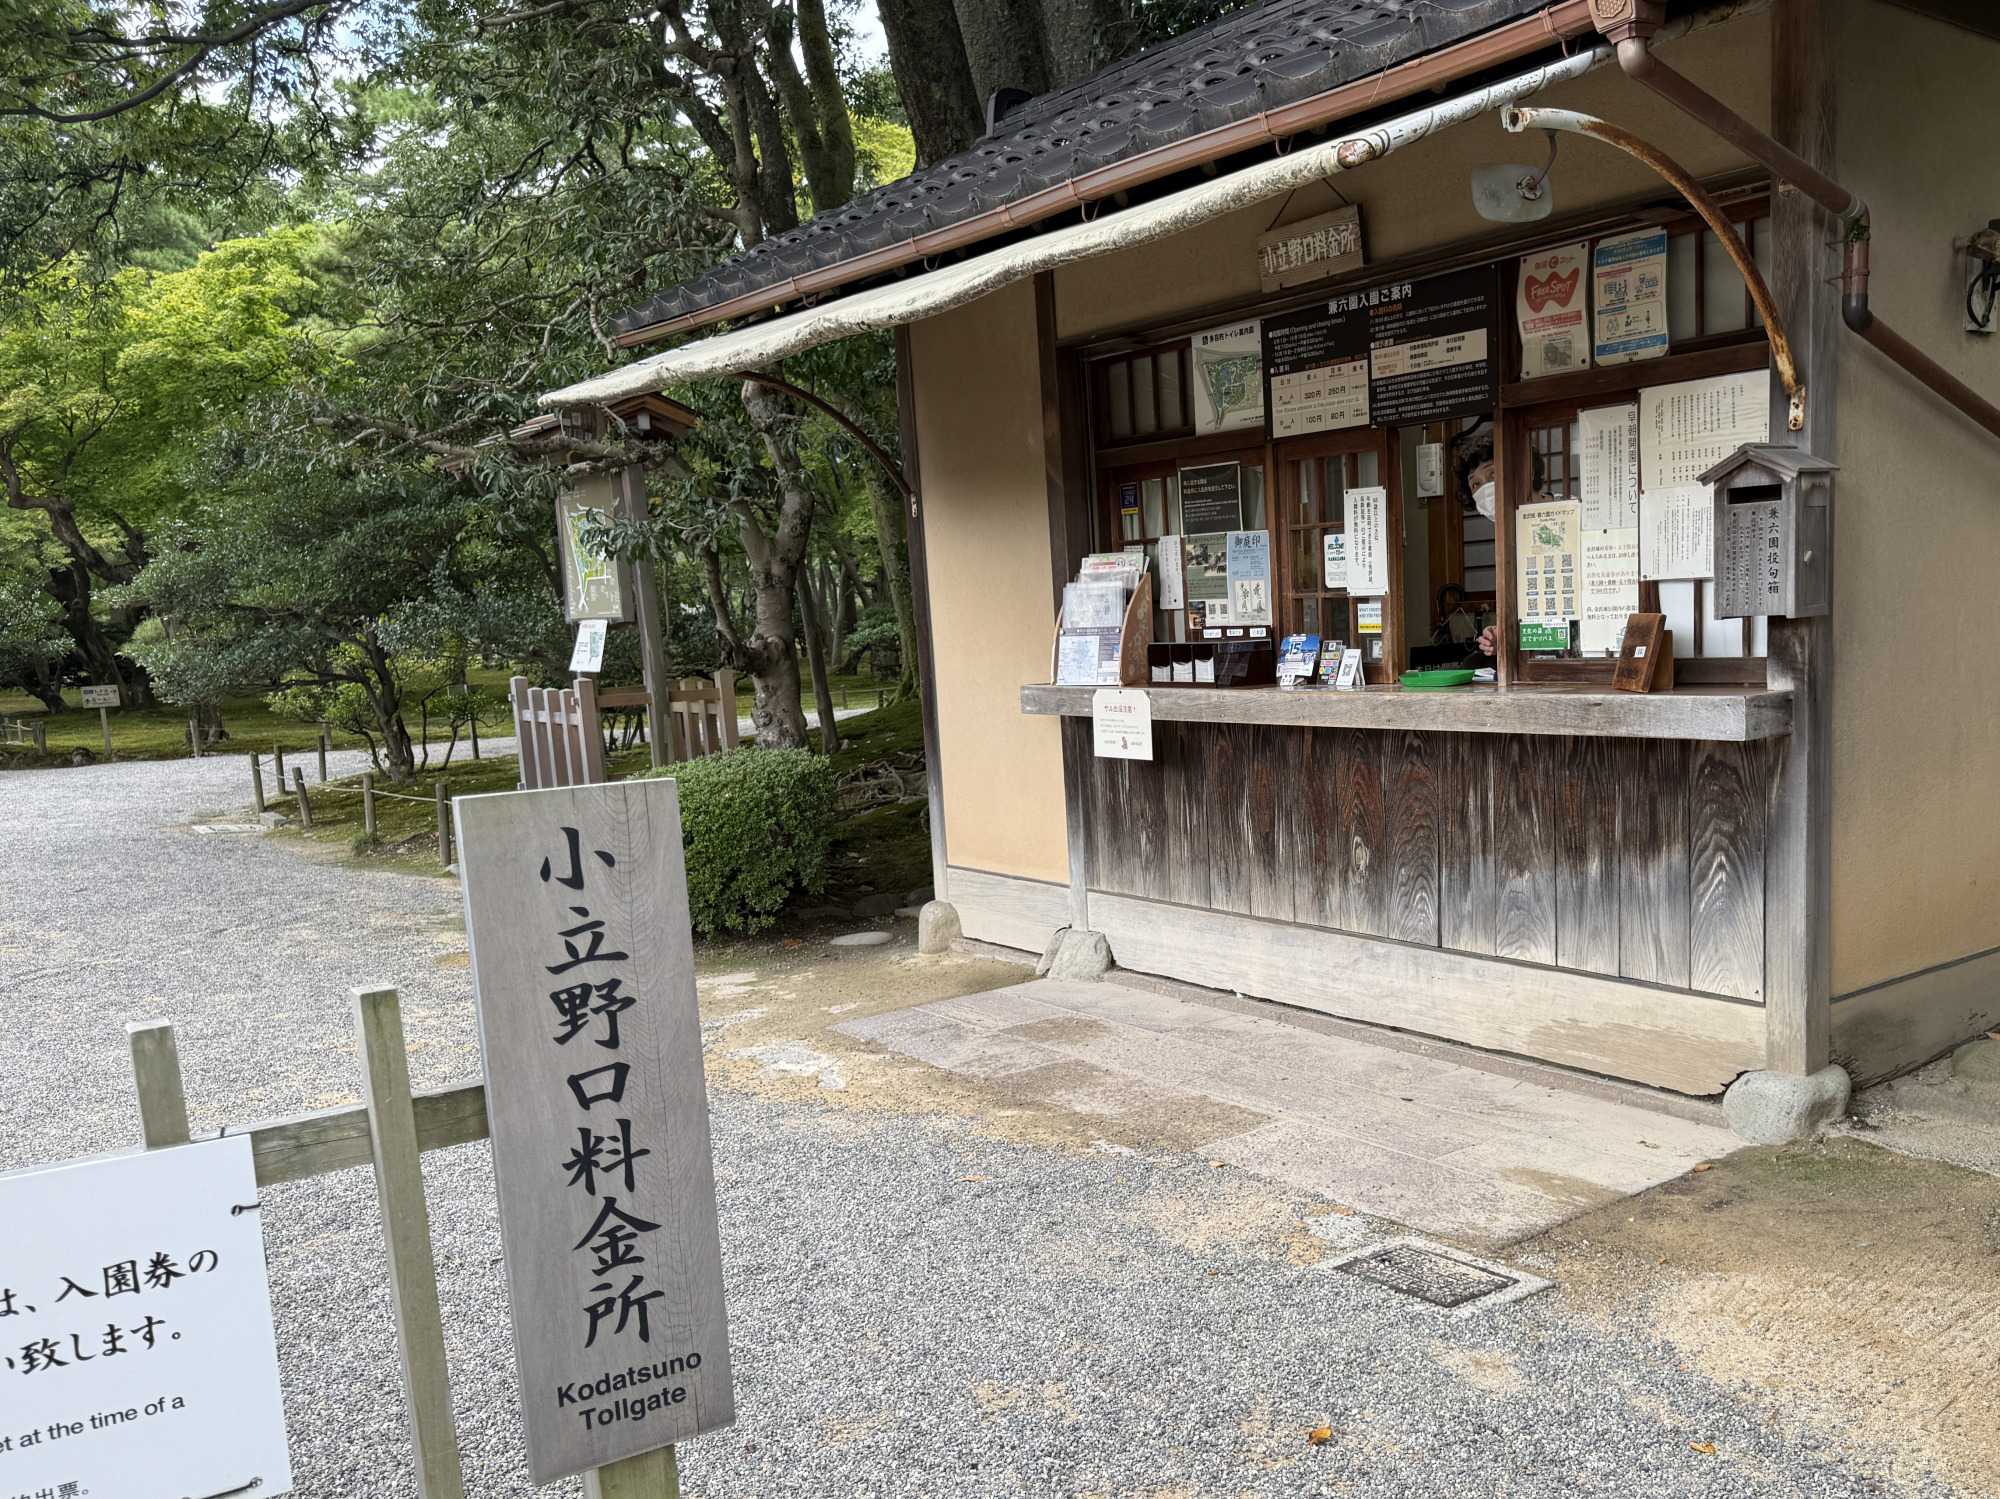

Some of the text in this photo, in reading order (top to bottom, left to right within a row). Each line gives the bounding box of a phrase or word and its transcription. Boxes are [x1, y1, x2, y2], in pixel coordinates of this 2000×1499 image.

[1264, 222, 1356, 273] 小立野口料金所
[1328, 283, 1412, 315] 兼六園入園ご案内
[1209, 325, 1254, 343] 多目的トイレ案内図
[1274, 364, 1290, 373] 入園料
[1278, 393, 1294, 401] 大人
[1304, 389, 1321, 399] 320円
[1328, 385, 1345, 396] 250円
[1305, 414, 1322, 424] 100円
[1331, 411, 1345, 420] 80円
[1627, 411, 1637, 514] 早朝開園について
[1522, 509, 1575, 519] 金沢城・兼六園ガイドマップ
[1234, 534, 1261, 548] 御庭印
[1767, 506, 1779, 594] 兼六園投句箱
[1587, 552, 1638, 560] へ入られる方は、お申し出
[1289, 642, 1302, 655] 15
[539, 826, 664, 1348] 小立野口料金所
[557, 1352, 702, 1408] Kodatsuno
[578, 1386, 687, 1430] Tollgate
[20, 1429, 42, 1447] at
[48, 1422, 84, 1440] the
[89, 1408, 138, 1429] time
[144, 1397, 165, 1416] of
[171, 1396, 185, 1409] a
[12, 1481, 89, 1499] 出票。
